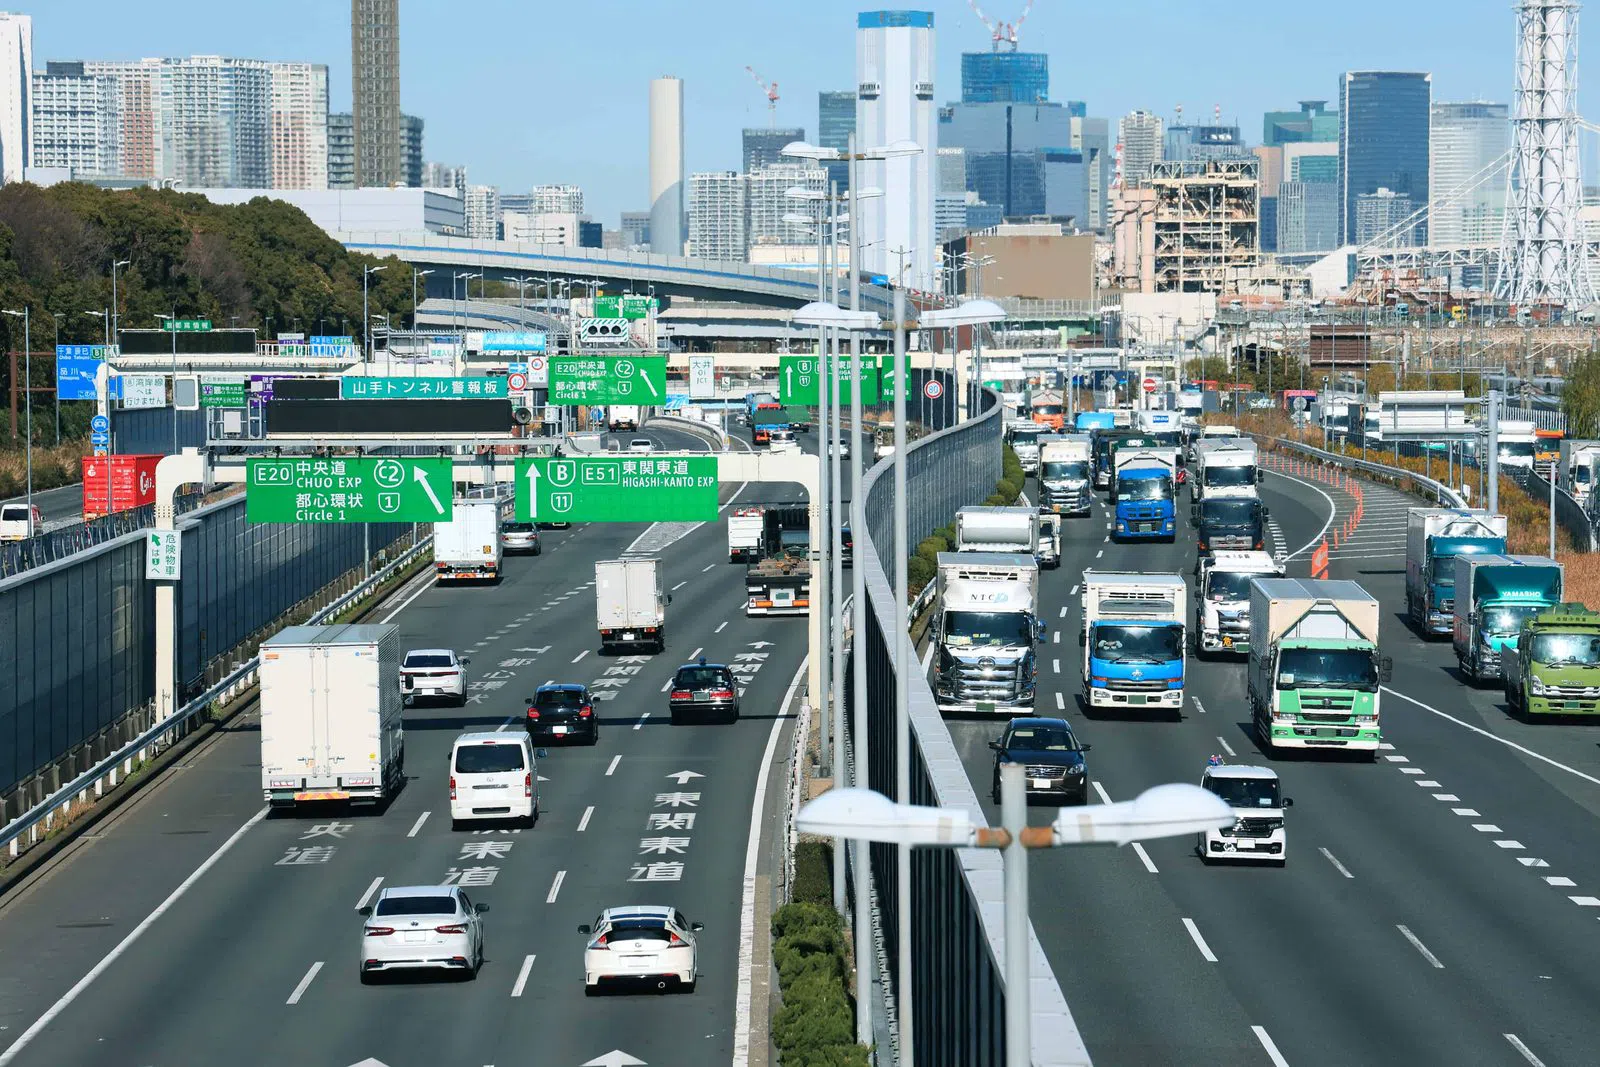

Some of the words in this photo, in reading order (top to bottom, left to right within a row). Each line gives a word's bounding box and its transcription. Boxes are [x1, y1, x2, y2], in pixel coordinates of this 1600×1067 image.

[557, 364, 575, 373] E20
[578, 361, 606, 370] 中央道
[617, 363, 631, 375] C2
[693, 361, 711, 369] 大井
[352, 381, 498, 395] 山手トンネル警報板
[928, 386, 938, 394] 80
[556, 391, 579, 399] Circle
[126, 397, 164, 406] 行けません
[296, 461, 346, 476] 中央道
[378, 465, 399, 482] C2
[557, 466, 568, 481] B
[622, 460, 689, 475] 東関東道
[258, 467, 290, 481] E20
[585, 467, 615, 481] E51
[296, 477, 333, 488] CHUO
[338, 477, 362, 488] EXP
[622, 476, 694, 488] HIGASHI-KANTO
[697, 476, 714, 487] EXP
[296, 493, 364, 508] 都心環状
[385, 496, 393, 508] 1
[555, 495, 567, 508] 11
[296, 509, 333, 521] Circle
[338, 509, 346, 521] 1
[166, 533, 177, 575] 危険物車
[626, 792, 702, 882] 東関東道
